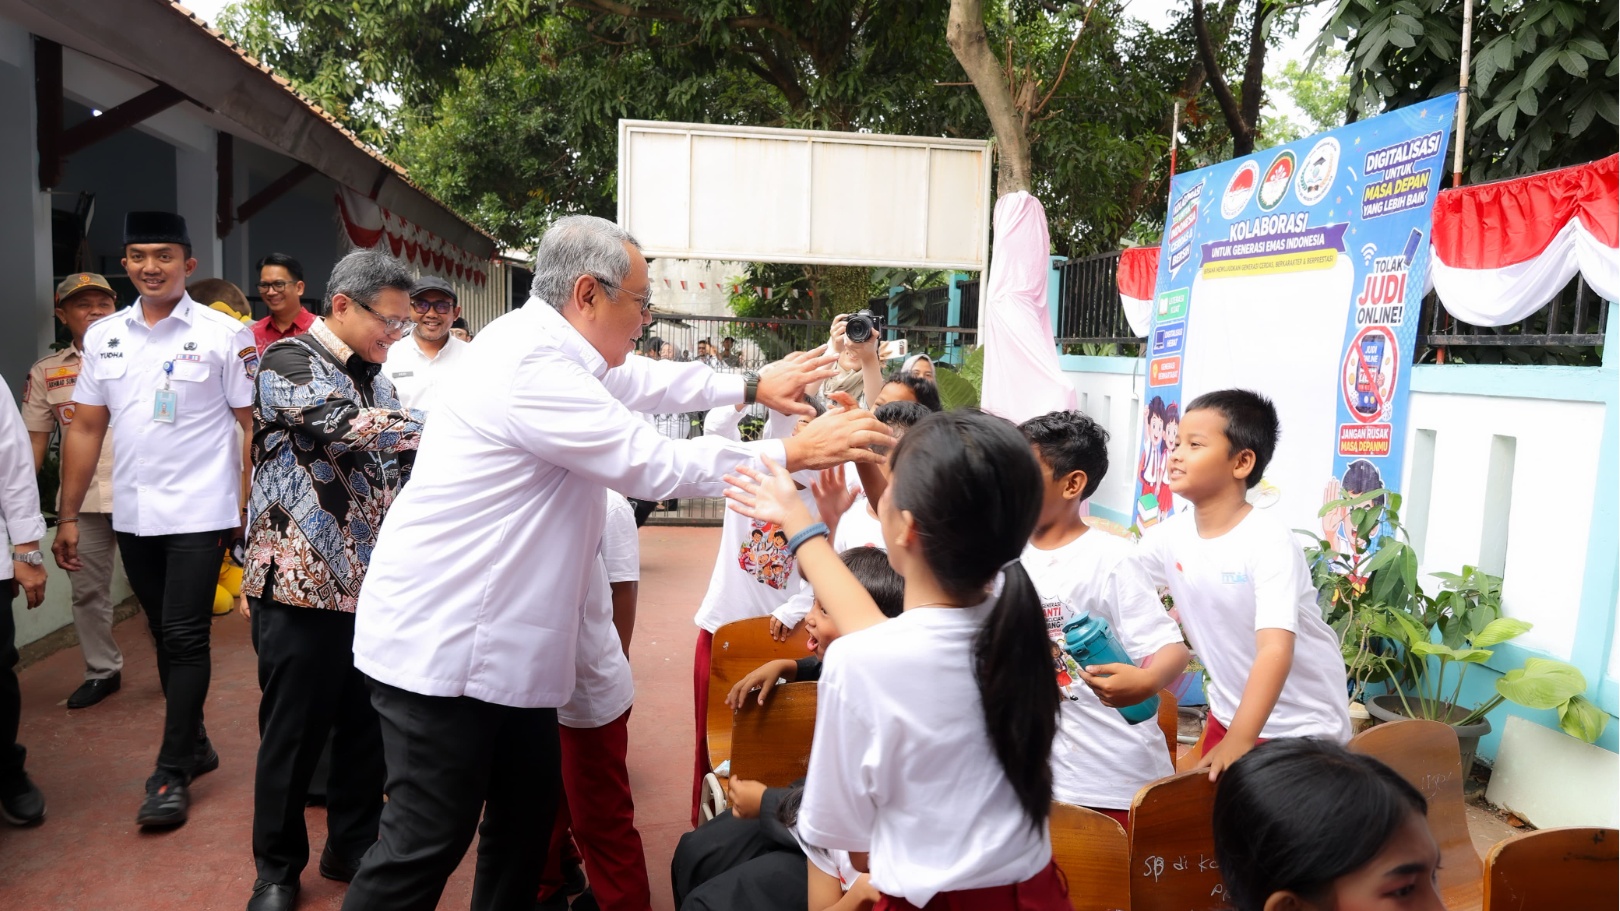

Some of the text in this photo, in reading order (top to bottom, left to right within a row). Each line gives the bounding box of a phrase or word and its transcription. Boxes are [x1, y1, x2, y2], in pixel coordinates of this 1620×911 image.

[1365, 134, 1440, 172] DIGITALISASI
[1384, 162, 1414, 181] UNTUK
[1363, 171, 1430, 202] MASA DEPAN
[1362, 190, 1427, 217] YANG LEBIH BAIK
[1229, 212, 1309, 243] KOLABORASI
[1211, 233, 1325, 258] UNTUK GENERASI EMAS INDONESIA
[1275, 258, 1302, 268] BERKARAKTER
[1306, 255, 1334, 265] BERPRESTASI
[1375, 258, 1404, 274] TOLAK
[1358, 273, 1407, 306] JUDI
[1357, 306, 1403, 324] ONLINE!
[1364, 345, 1378, 354] JUDI
[1341, 428, 1388, 439] JANGAN RUSAK
[1340, 441, 1388, 452] MASA DEPANMU
[1043, 607, 1061, 617] ANTI
[1173, 855, 1188, 870] di
